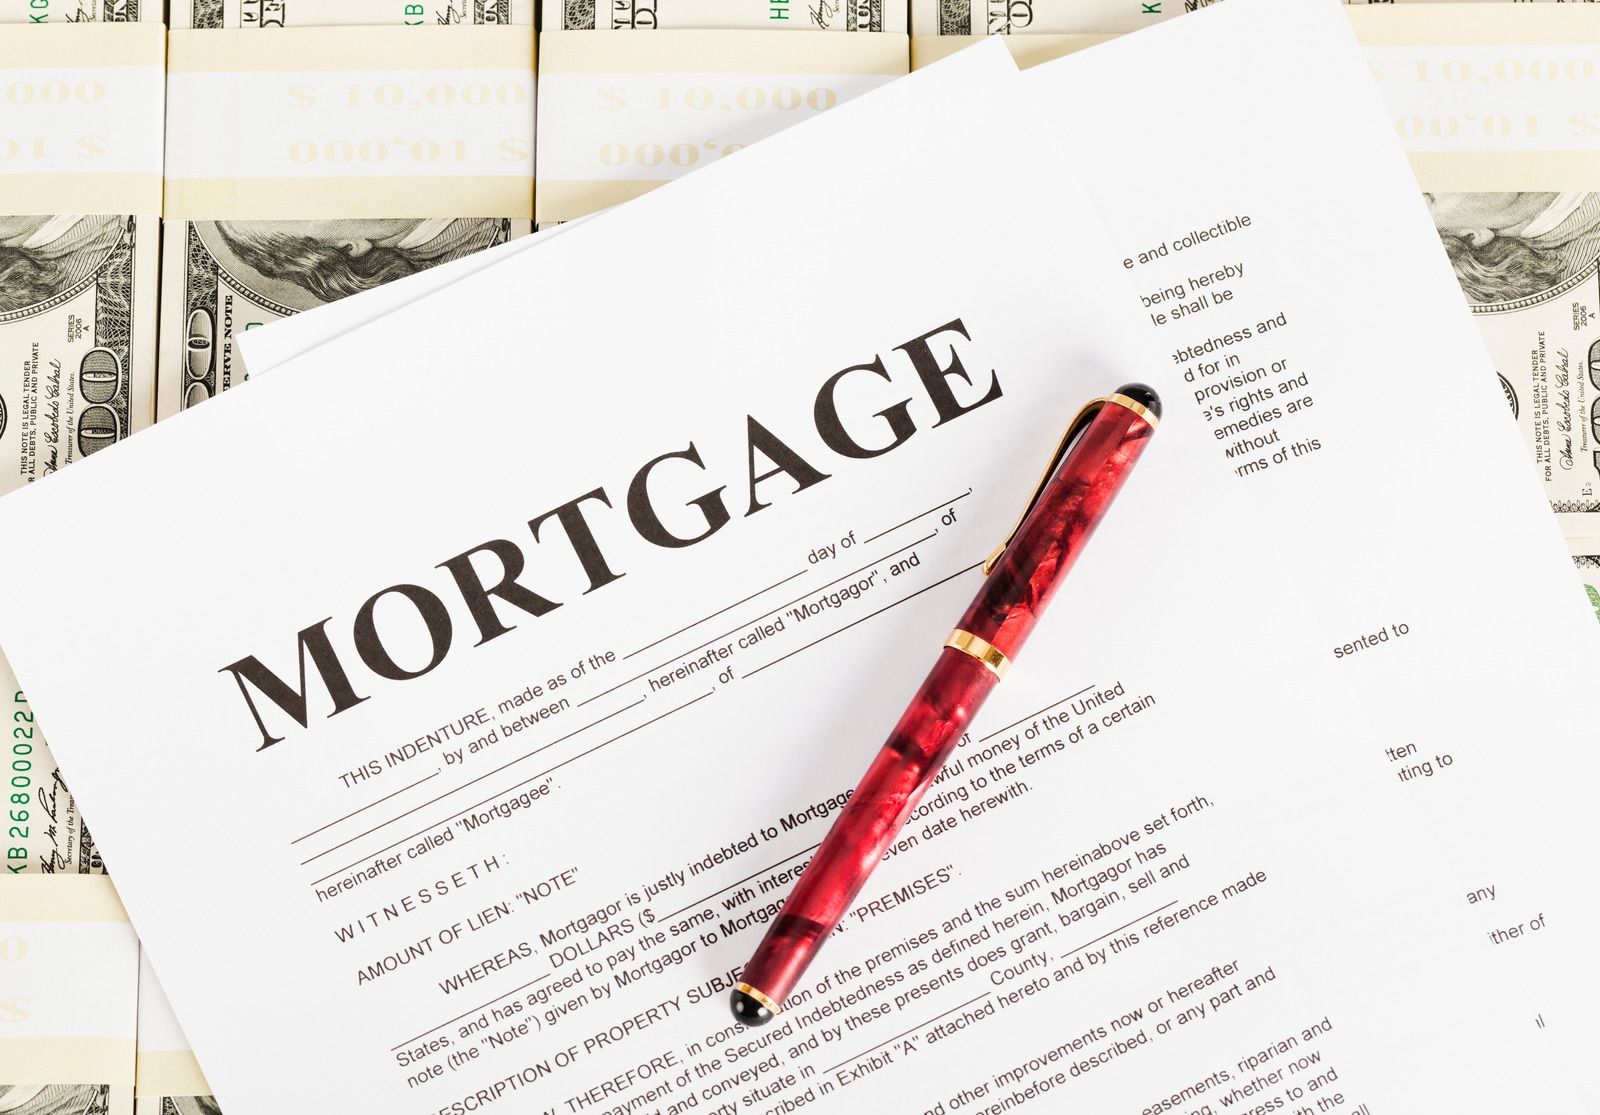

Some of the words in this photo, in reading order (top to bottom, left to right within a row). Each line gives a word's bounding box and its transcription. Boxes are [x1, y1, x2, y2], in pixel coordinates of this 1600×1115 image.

[1137, 241, 1169, 265] and
[1172, 215, 1252, 252] collectible
[1187, 262, 1244, 292] hereby
[224, 295, 233, 340] NOTE
[1170, 294, 1210, 320] shall
[1210, 289, 1234, 305] be
[1572, 302, 1580, 331] SERIES
[1197, 360, 1220, 378] for
[1223, 354, 1241, 368] in
[1538, 331, 1546, 364] PRIVATE
[23, 360, 31, 393] TENDER
[1193, 367, 1268, 406] provision
[1270, 358, 1287, 374] or
[1228, 387, 1275, 413] rights
[1277, 371, 1309, 395] and
[1533, 383, 1541, 409] LEGAL
[22, 394, 30, 420] LEGAL
[30, 396, 38, 426] PUBLIC
[1285, 396, 1314, 414] are
[1534, 411, 1541, 419] IS
[1541, 385, 1549, 415] PUBLIC
[21, 432, 29, 453] NOTE
[22, 422, 29, 430] IS
[1534, 421, 1542, 443] NOTE
[1272, 446, 1289, 465] of
[1290, 437, 1322, 458] this
[1535, 444, 1543, 463] THIS
[218, 318, 1003, 752] MORTGAGE
[442, 747, 464, 766] by
[467, 728, 499, 754] and
[499, 698, 571, 738] between
[940, 506, 958, 527] of
[647, 642, 734, 693] hereinafter
[737, 616, 786, 650] called
[785, 569, 888, 623] "Mortgagor",
[889, 550, 921, 577] and
[1333, 626, 1390, 659] sented
[1391, 623, 1410, 638] to
[337, 759, 383, 789] THIS
[383, 707, 496, 769] INDENTURE,
[497, 685, 544, 715] made
[546, 674, 568, 691] as
[570, 659, 587, 680] of
[588, 650, 617, 671] the
[807, 543, 837, 565] day
[840, 529, 857, 549] of
[718, 664, 735, 685] of
[314, 852, 403, 903] hereinafter
[406, 825, 455, 859] called
[454, 776, 561, 833] "Mortgagee".
[437, 941, 539, 995] WHEREAS,
[538, 899, 622, 948] Mortgagor
[624, 892, 642, 907] is
[641, 869, 686, 903] justly
[686, 831, 760, 877] indebted
[759, 826, 779, 842] to
[815, 975, 833, 995] of
[833, 965, 863, 985] the
[864, 928, 939, 975] premises
[941, 907, 974, 934] and
[973, 897, 1003, 917] the
[1004, 878, 1041, 903] sum
[1040, 830, 1141, 885] hereinabove
[1143, 813, 1171, 836] set
[1169, 795, 1215, 822] forth,
[848, 863, 962, 923] "PREMISES".
[1466, 884, 1496, 905] any
[357, 936, 433, 987] AMOUNT
[438, 922, 463, 945] OF
[466, 901, 515, 932] LIEN:
[515, 866, 579, 905] "NOTE"
[548, 918, 635, 969] DOLLARS
[395, 1035, 456, 1068] States,
[457, 1012, 490, 1039] and
[490, 1000, 524, 1023] has
[526, 967, 584, 1006] agreed
[584, 961, 604, 977] to
[605, 944, 636, 972] pay
[637, 931, 667, 952] the
[668, 908, 721, 937] same,
[720, 886, 757, 912] with
[675, 1068, 693, 1088] of
[693, 1058, 723, 1079] the
[724, 1020, 794, 1064] Secured
[794, 970, 905, 1030] Indebtedness
[907, 959, 929, 976] as
[931, 924, 992, 964] defined
[991, 902, 1050, 934] herein,
[1050, 857, 1133, 905] Mortgagor
[1134, 843, 1167, 865] has
[816, 1081, 835, 1096] in
[835, 1050, 895, 1087] Exhibit
[893, 1034, 919, 1056] "A"
[925, 999, 996, 1045] attached
[996, 977, 1051, 1009] hereto
[1052, 956, 1085, 983] and
[1084, 947, 1107, 966] by
[1108, 933, 1140, 954] this
[1142, 894, 1219, 939] reference
[1220, 871, 1268, 900] made
[990, 951, 1054, 986] County,
[407, 1064, 444, 1089] note
[447, 1047, 480, 1072] (the
[480, 1014, 542, 1049] "Note")
[544, 994, 589, 1026] given
[589, 982, 612, 1001] by
[613, 940, 697, 989] Mortgagor
[699, 932, 719, 948] to
[948, 1081, 990, 1110] other
[991, 1026, 1108, 1089] improvements
[1109, 1007, 1144, 1032] now
[1147, 996, 1164, 1014] or
[1165, 959, 1239, 1004] hereafter
[1237, 1036, 1299, 1073] riparian
[1300, 1015, 1333, 1042] and
[1218, 1068, 1284, 1108] whether
[1287, 1050, 1321, 1075] now
